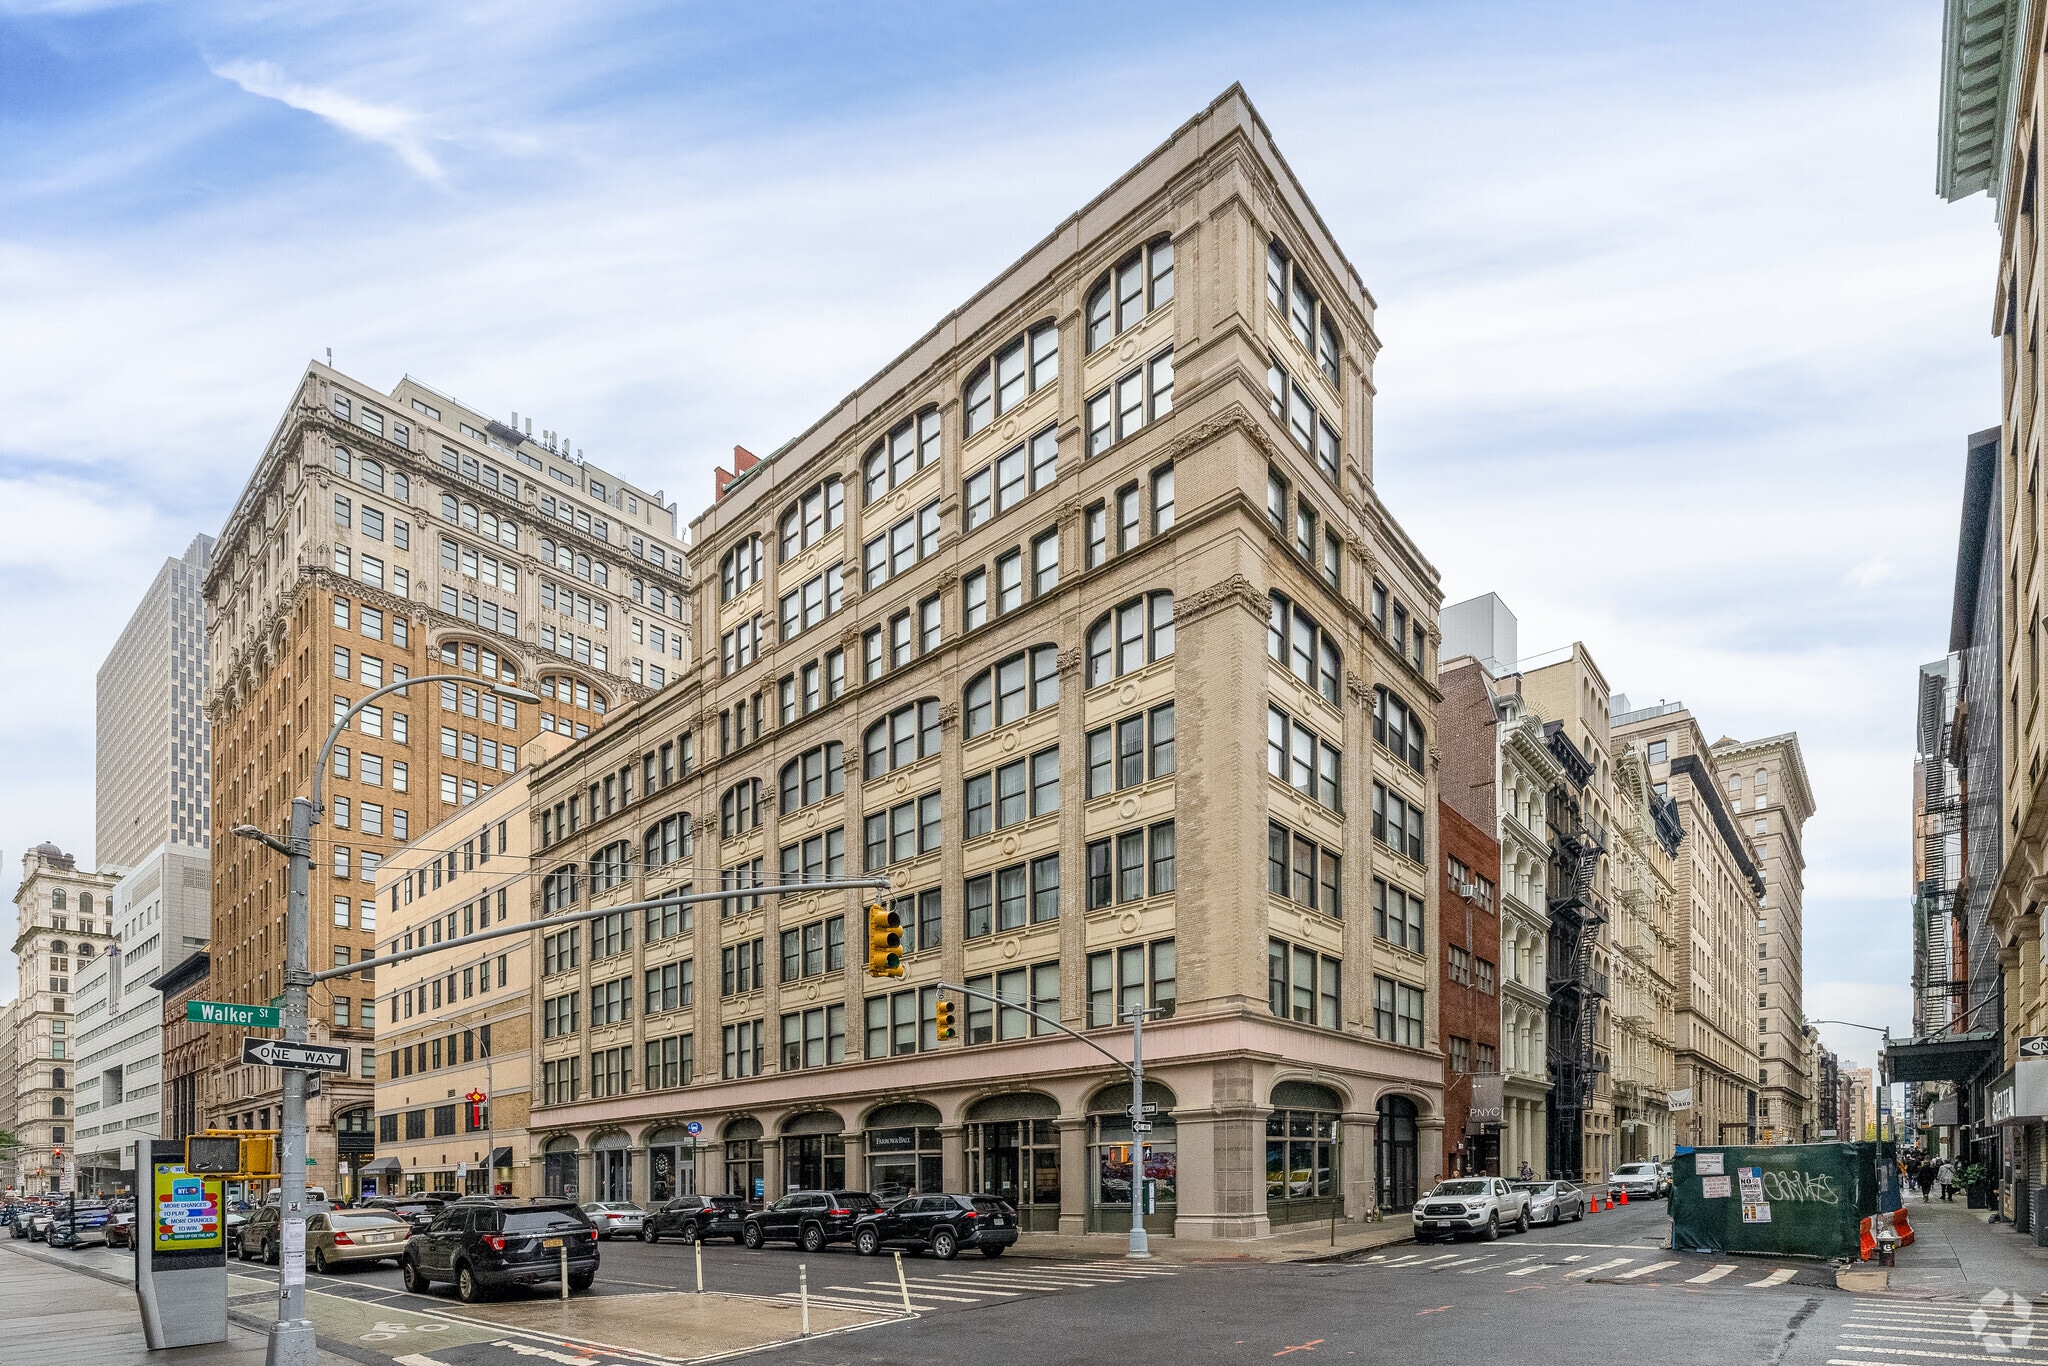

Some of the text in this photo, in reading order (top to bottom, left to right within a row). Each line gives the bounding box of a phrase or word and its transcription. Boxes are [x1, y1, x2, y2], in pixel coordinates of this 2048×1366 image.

[201, 1004, 254, 1023] Walker
[259, 1008, 269, 1018] St
[2031, 1042, 2048, 1051] ON
[260, 1047, 335, 1065] ONE WAY
